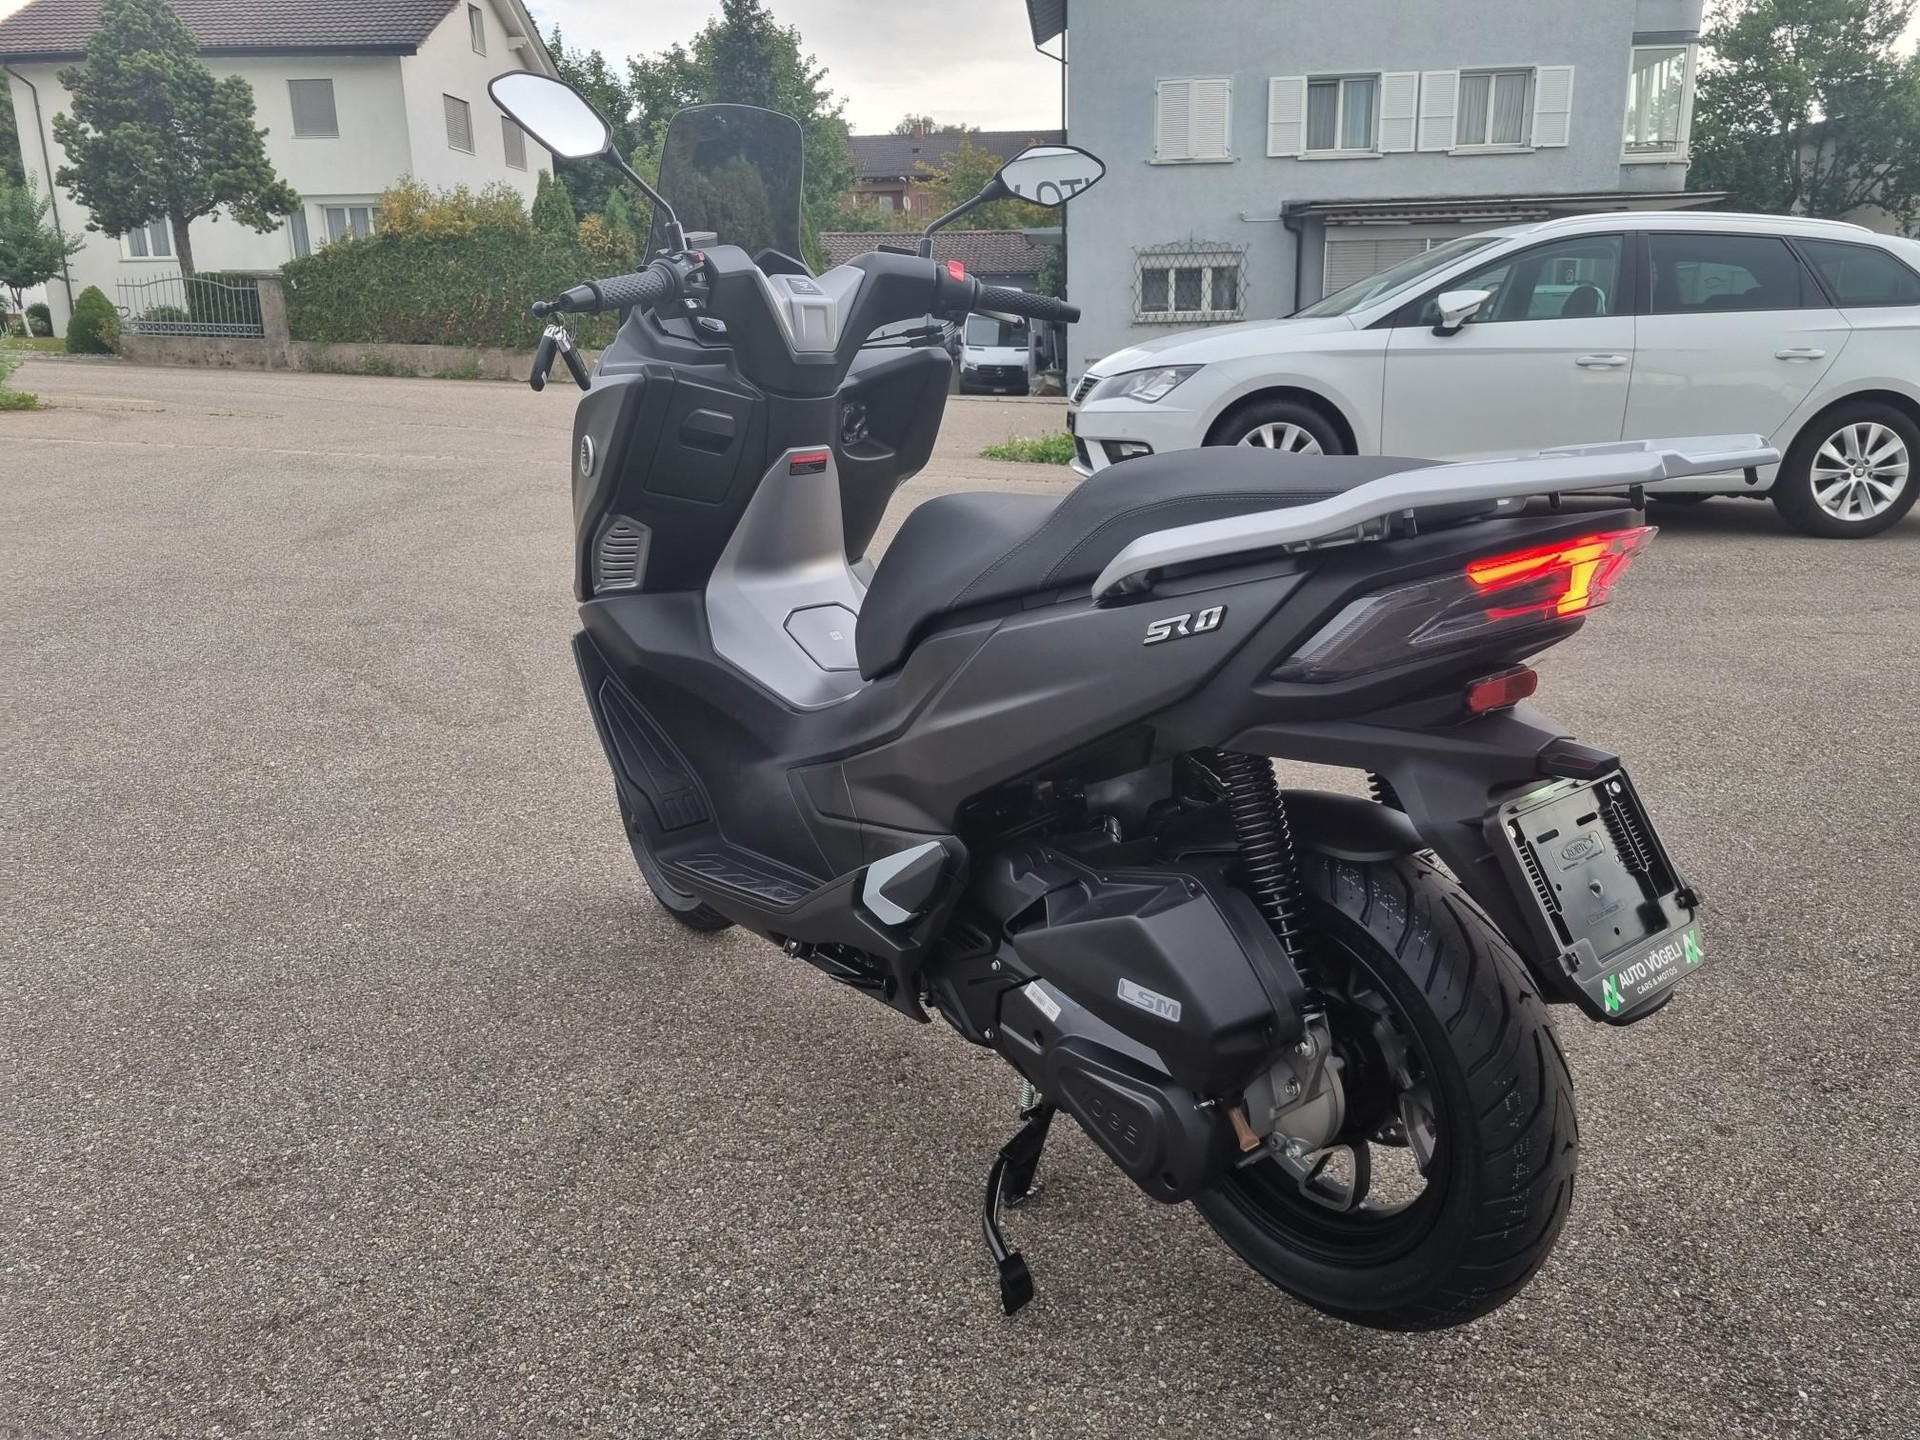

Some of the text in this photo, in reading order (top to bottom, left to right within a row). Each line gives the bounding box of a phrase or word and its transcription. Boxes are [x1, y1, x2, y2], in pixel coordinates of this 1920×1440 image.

[1618, 941, 1683, 990] AUTO VÖGELI
[1636, 980, 1653, 995] CARS
[1656, 966, 1679, 983] MOTOS
[1119, 979, 1179, 1020] LSM
